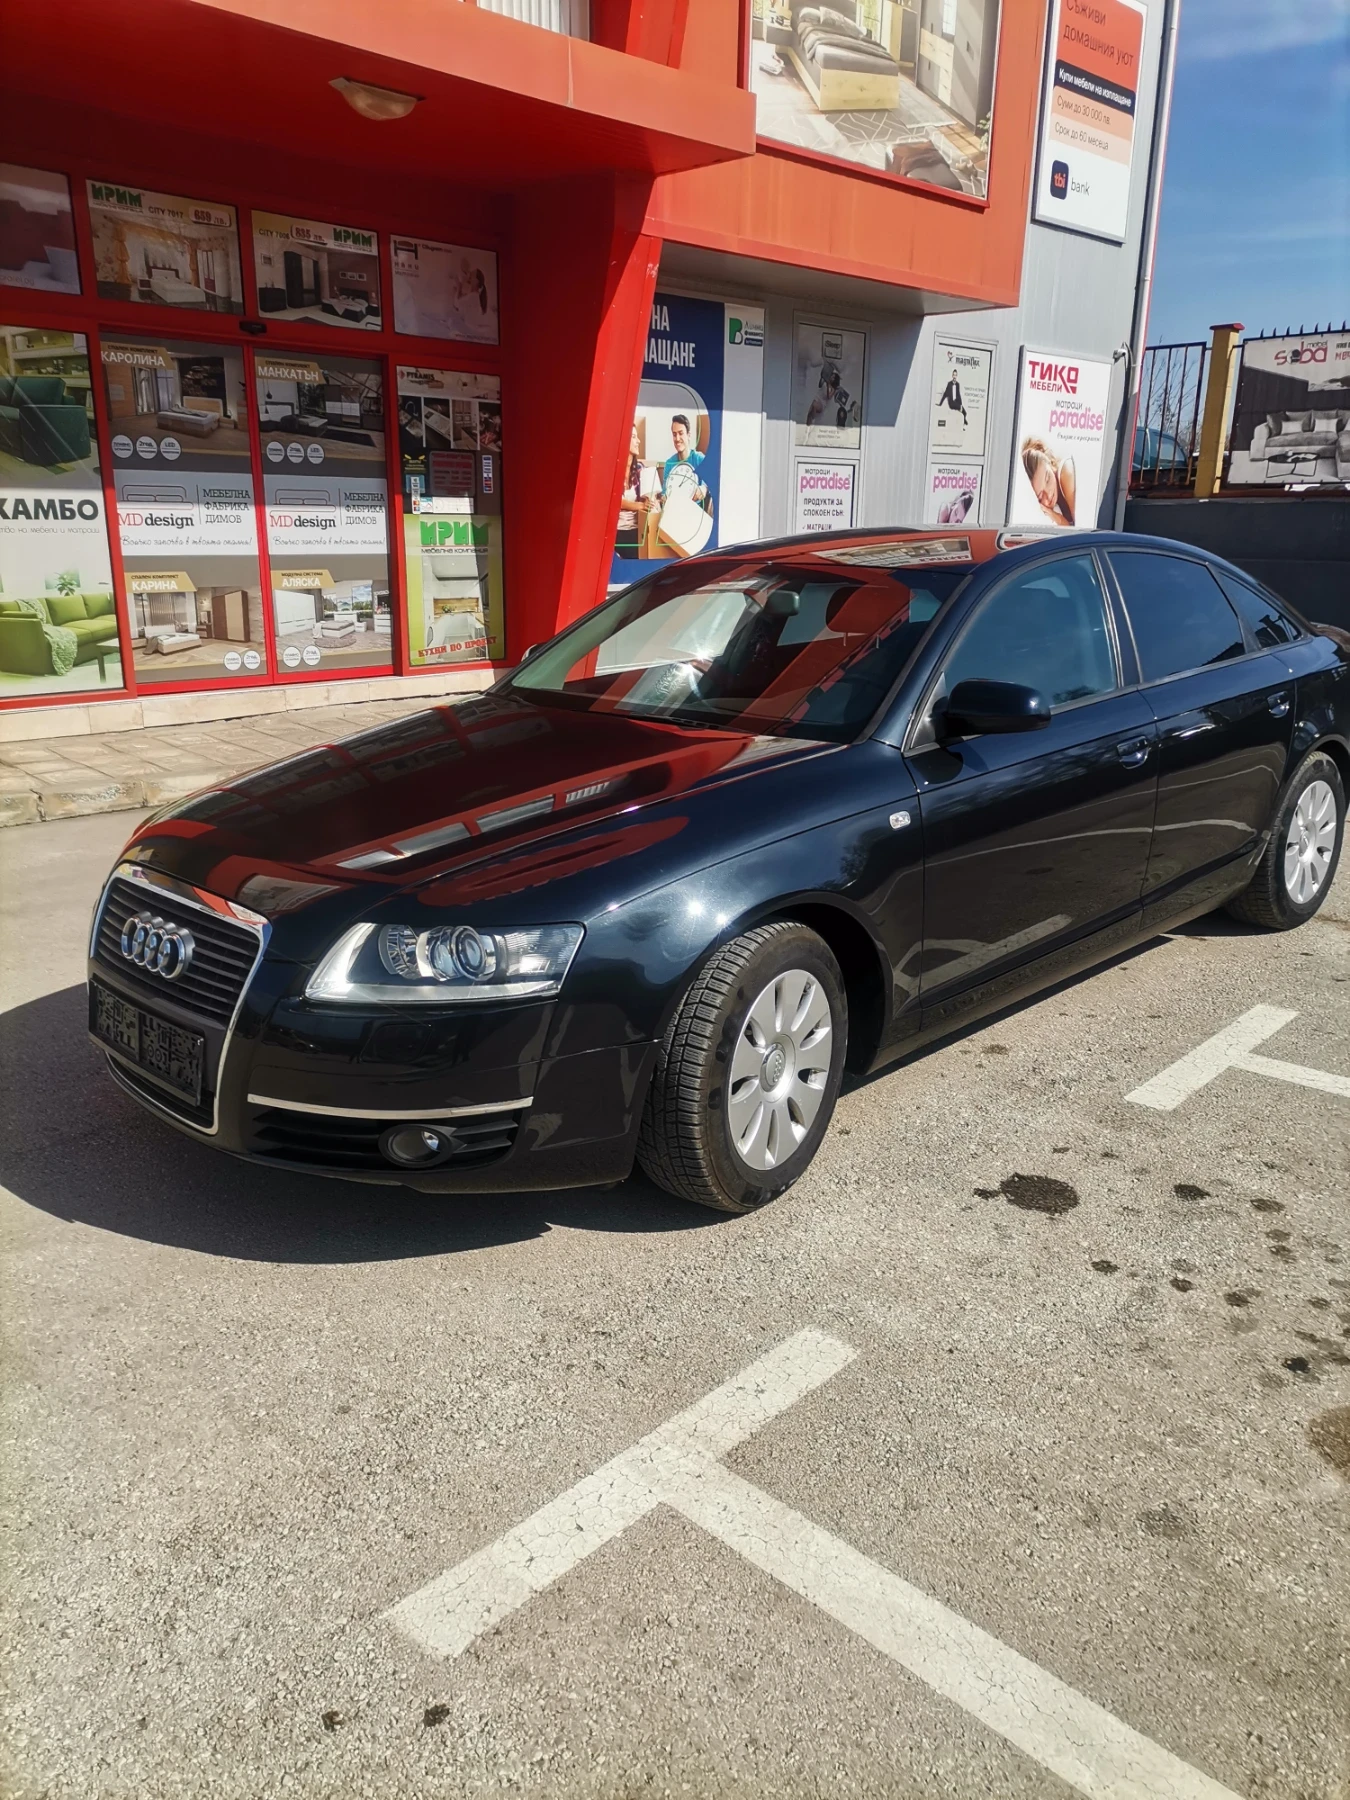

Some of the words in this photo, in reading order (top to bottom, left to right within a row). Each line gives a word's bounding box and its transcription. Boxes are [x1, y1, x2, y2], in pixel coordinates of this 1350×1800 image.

[1066, 0, 1106, 26] Съживи
[1063, 25, 1115, 58] домашния
[1116, 49, 1134, 66] уют
[1059, 68, 1074, 82] Купи
[1073, 73, 1095, 92] мебели
[1094, 86, 1102, 95] на
[1102, 89, 1132, 107] изплащане
[1057, 95, 1073, 109] Суми
[1073, 105, 1082, 114] до
[1081, 105, 1090, 117] 30
[1090, 108, 1103, 121] 000
[1055, 121, 1070, 136] Срок
[1070, 128, 1079, 140] до
[1079, 130, 1088, 142] 60
[1087, 136, 1109, 150] месеца
[1054, 172, 1067, 188] tbi
[1071, 177, 1090, 196] bank
[91, 183, 143, 208] ИРИМ
[148, 206, 165, 217] CITY
[167, 208, 184, 219] 7017
[258, 228, 273, 237] CITY
[295, 227, 311, 240] 835
[333, 227, 373, 248] ИРИМ
[101, 350, 166, 367] КАРОЛИНА
[258, 366, 319, 381] МАНХАТЪН
[1030, 380, 1063, 393] МЕБЕЛИ
[1056, 400, 1083, 410] матраци
[1049, 407, 1104, 433] paradise
[804, 468, 831, 476] матраци
[937, 468, 961, 476] матраци
[800, 472, 851, 494] paradise
[933, 471, 978, 493] paradise
[202, 488, 251, 499] МЕБЕЛНА
[343, 492, 386, 502] МЕБЕЛНА
[203, 501, 250, 511] ФАБРИКА
[344, 504, 385, 513] ФАБРИКА
[803, 498, 835, 507] ПРОДУКТИ
[835, 498, 844, 506] ЗА
[803, 508, 831, 517] СПОКОЕН
[205, 514, 243, 525] ДИМОВ
[345, 515, 378, 526] ДИМОВ
[30, 526, 58, 534] мебели
[67, 527, 100, 535] матраци
[420, 521, 489, 547] ИРИМ
[132, 579, 179, 591] КАРИНА
[282, 577, 321, 588] АЛЯСКА
[418, 646, 447, 658] КУХНИ
[449, 643, 462, 652] ПО
[464, 636, 497, 649] ПРОЕКТ
